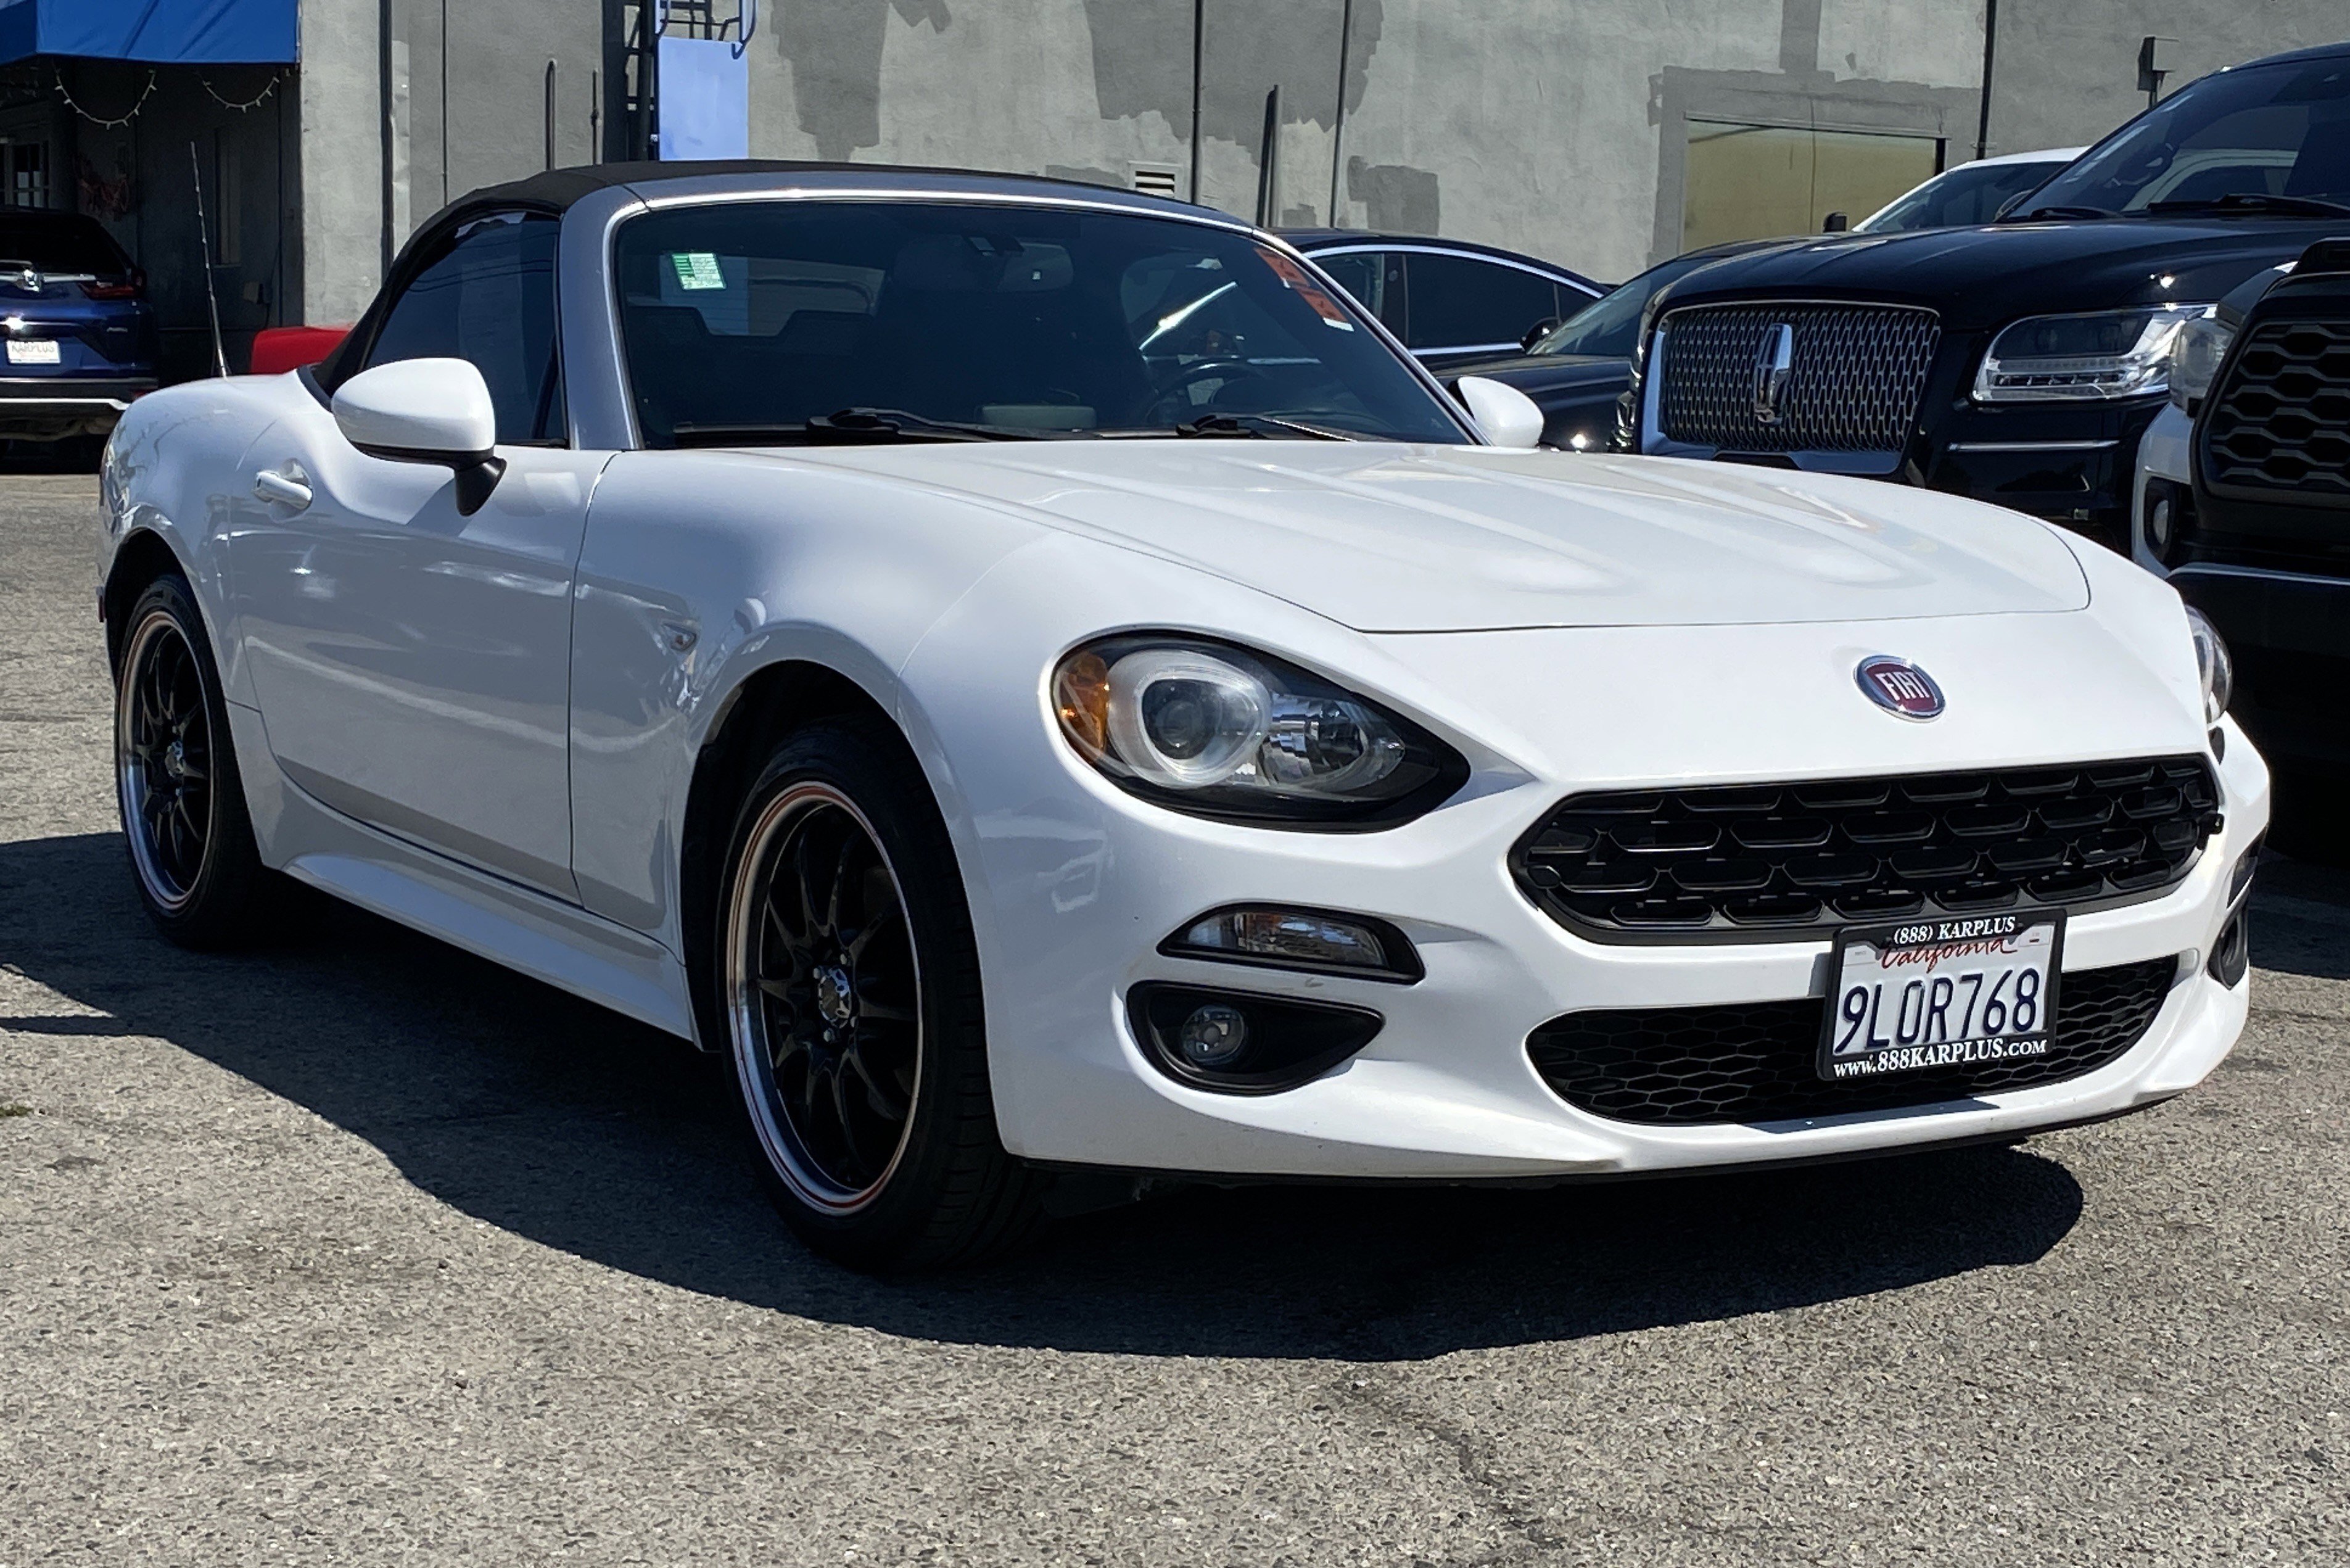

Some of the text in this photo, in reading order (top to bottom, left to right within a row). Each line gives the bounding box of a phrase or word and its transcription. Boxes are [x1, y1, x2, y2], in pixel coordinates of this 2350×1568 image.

[1875, 671, 1930, 701] FIAT
[1894, 925, 1933, 944] (888)
[1937, 917, 2016, 940] KARPLUS
[1881, 936, 2017, 973] California
